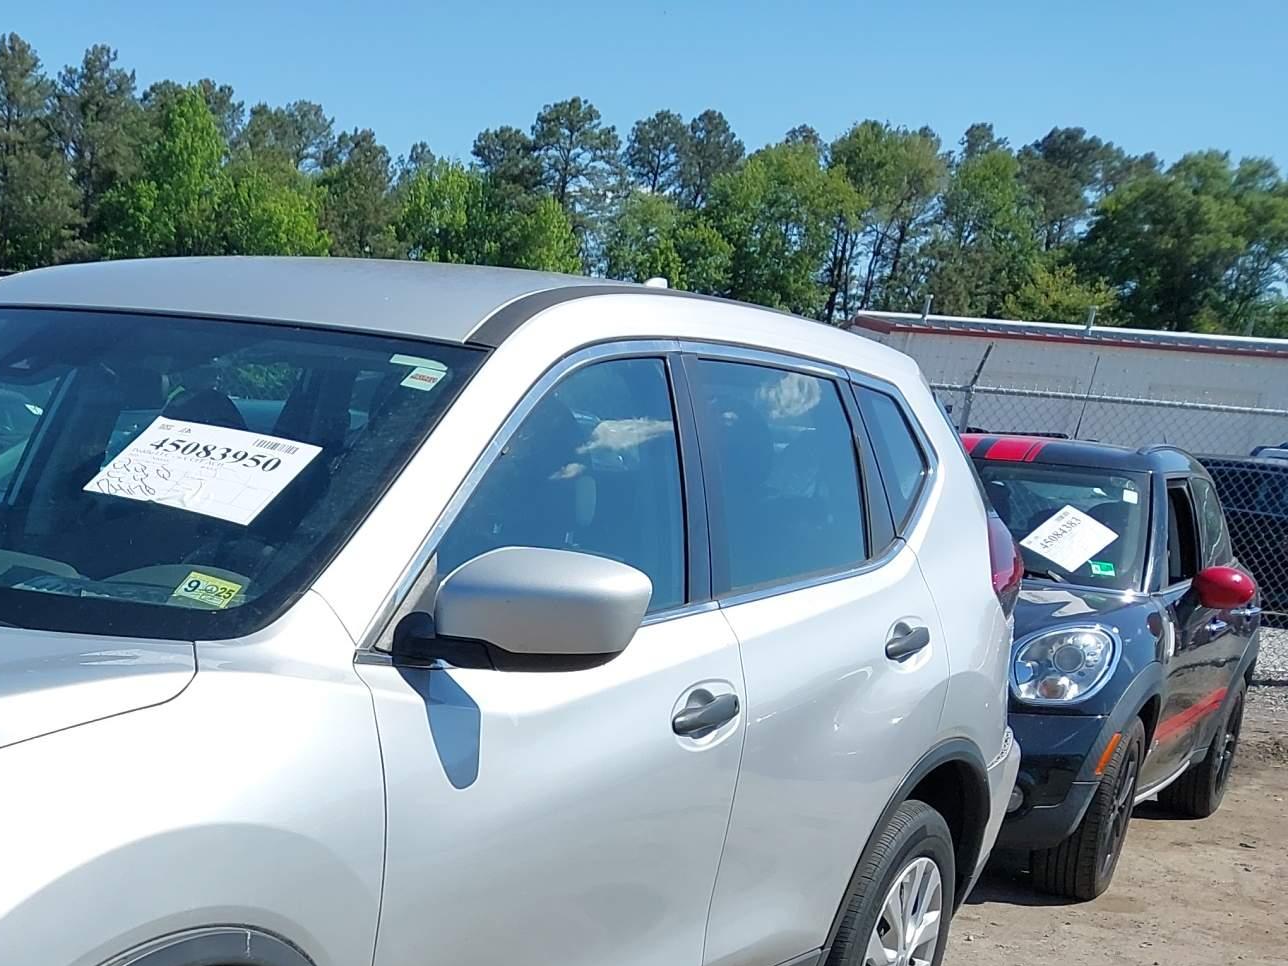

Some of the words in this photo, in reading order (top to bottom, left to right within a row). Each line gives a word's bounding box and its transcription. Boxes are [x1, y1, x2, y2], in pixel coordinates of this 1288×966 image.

[150, 438, 282, 472] 45083950
[184, 579, 200, 592] 9
[215, 586, 235, 599] 25
